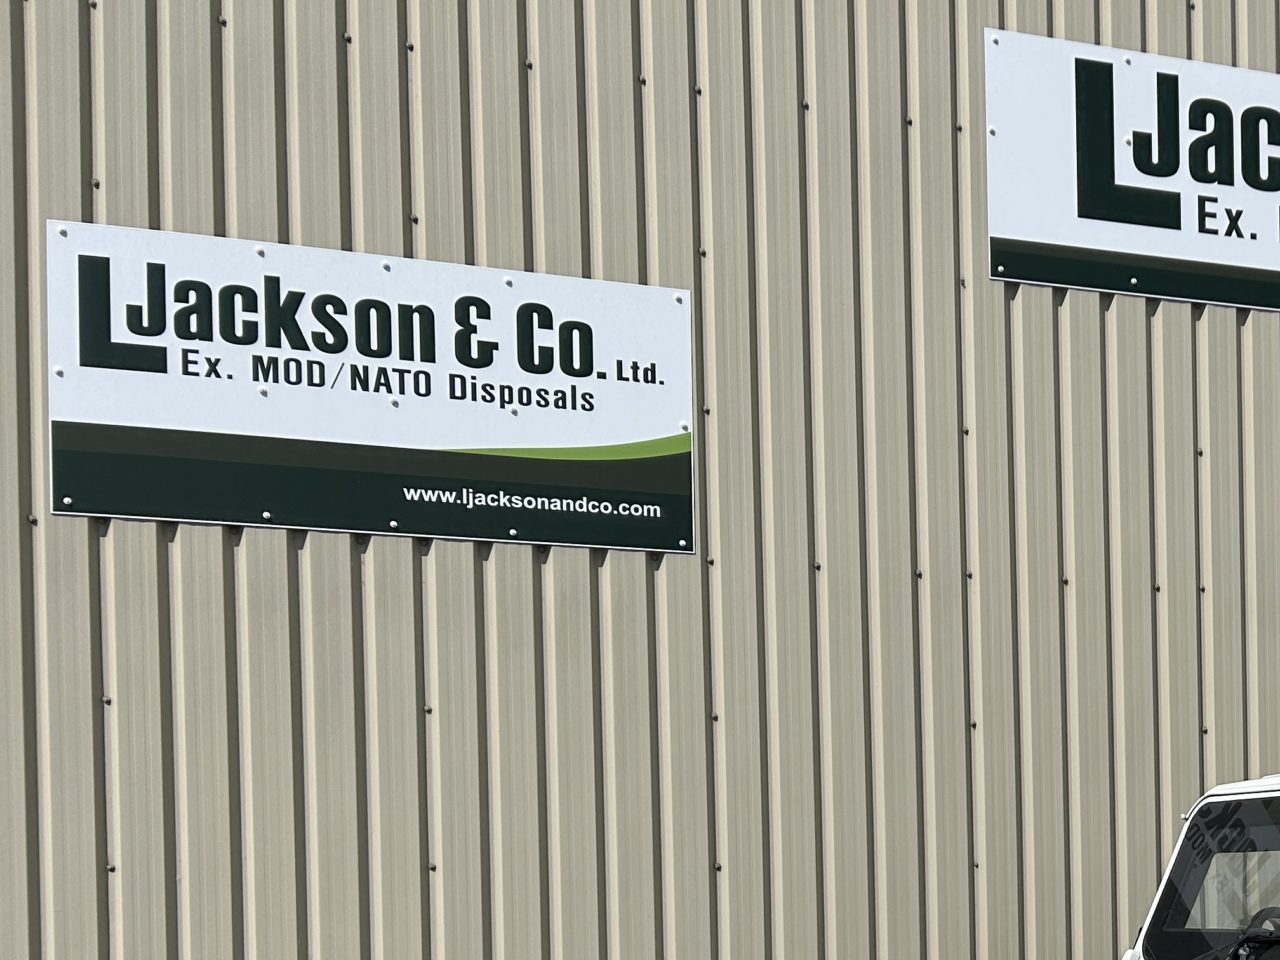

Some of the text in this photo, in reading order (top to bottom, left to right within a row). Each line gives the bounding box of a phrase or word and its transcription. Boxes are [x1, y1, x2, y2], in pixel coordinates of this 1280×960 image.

[1197, 194, 1258, 240] Ex.
[454, 295, 500, 370] &
[516, 302, 608, 381] Co.
[616, 359, 666, 387] Ltd.
[181, 347, 595, 412] Ex. MOD/NATO Disposals
[402, 485, 662, 518] www.ljacksonandco.com
